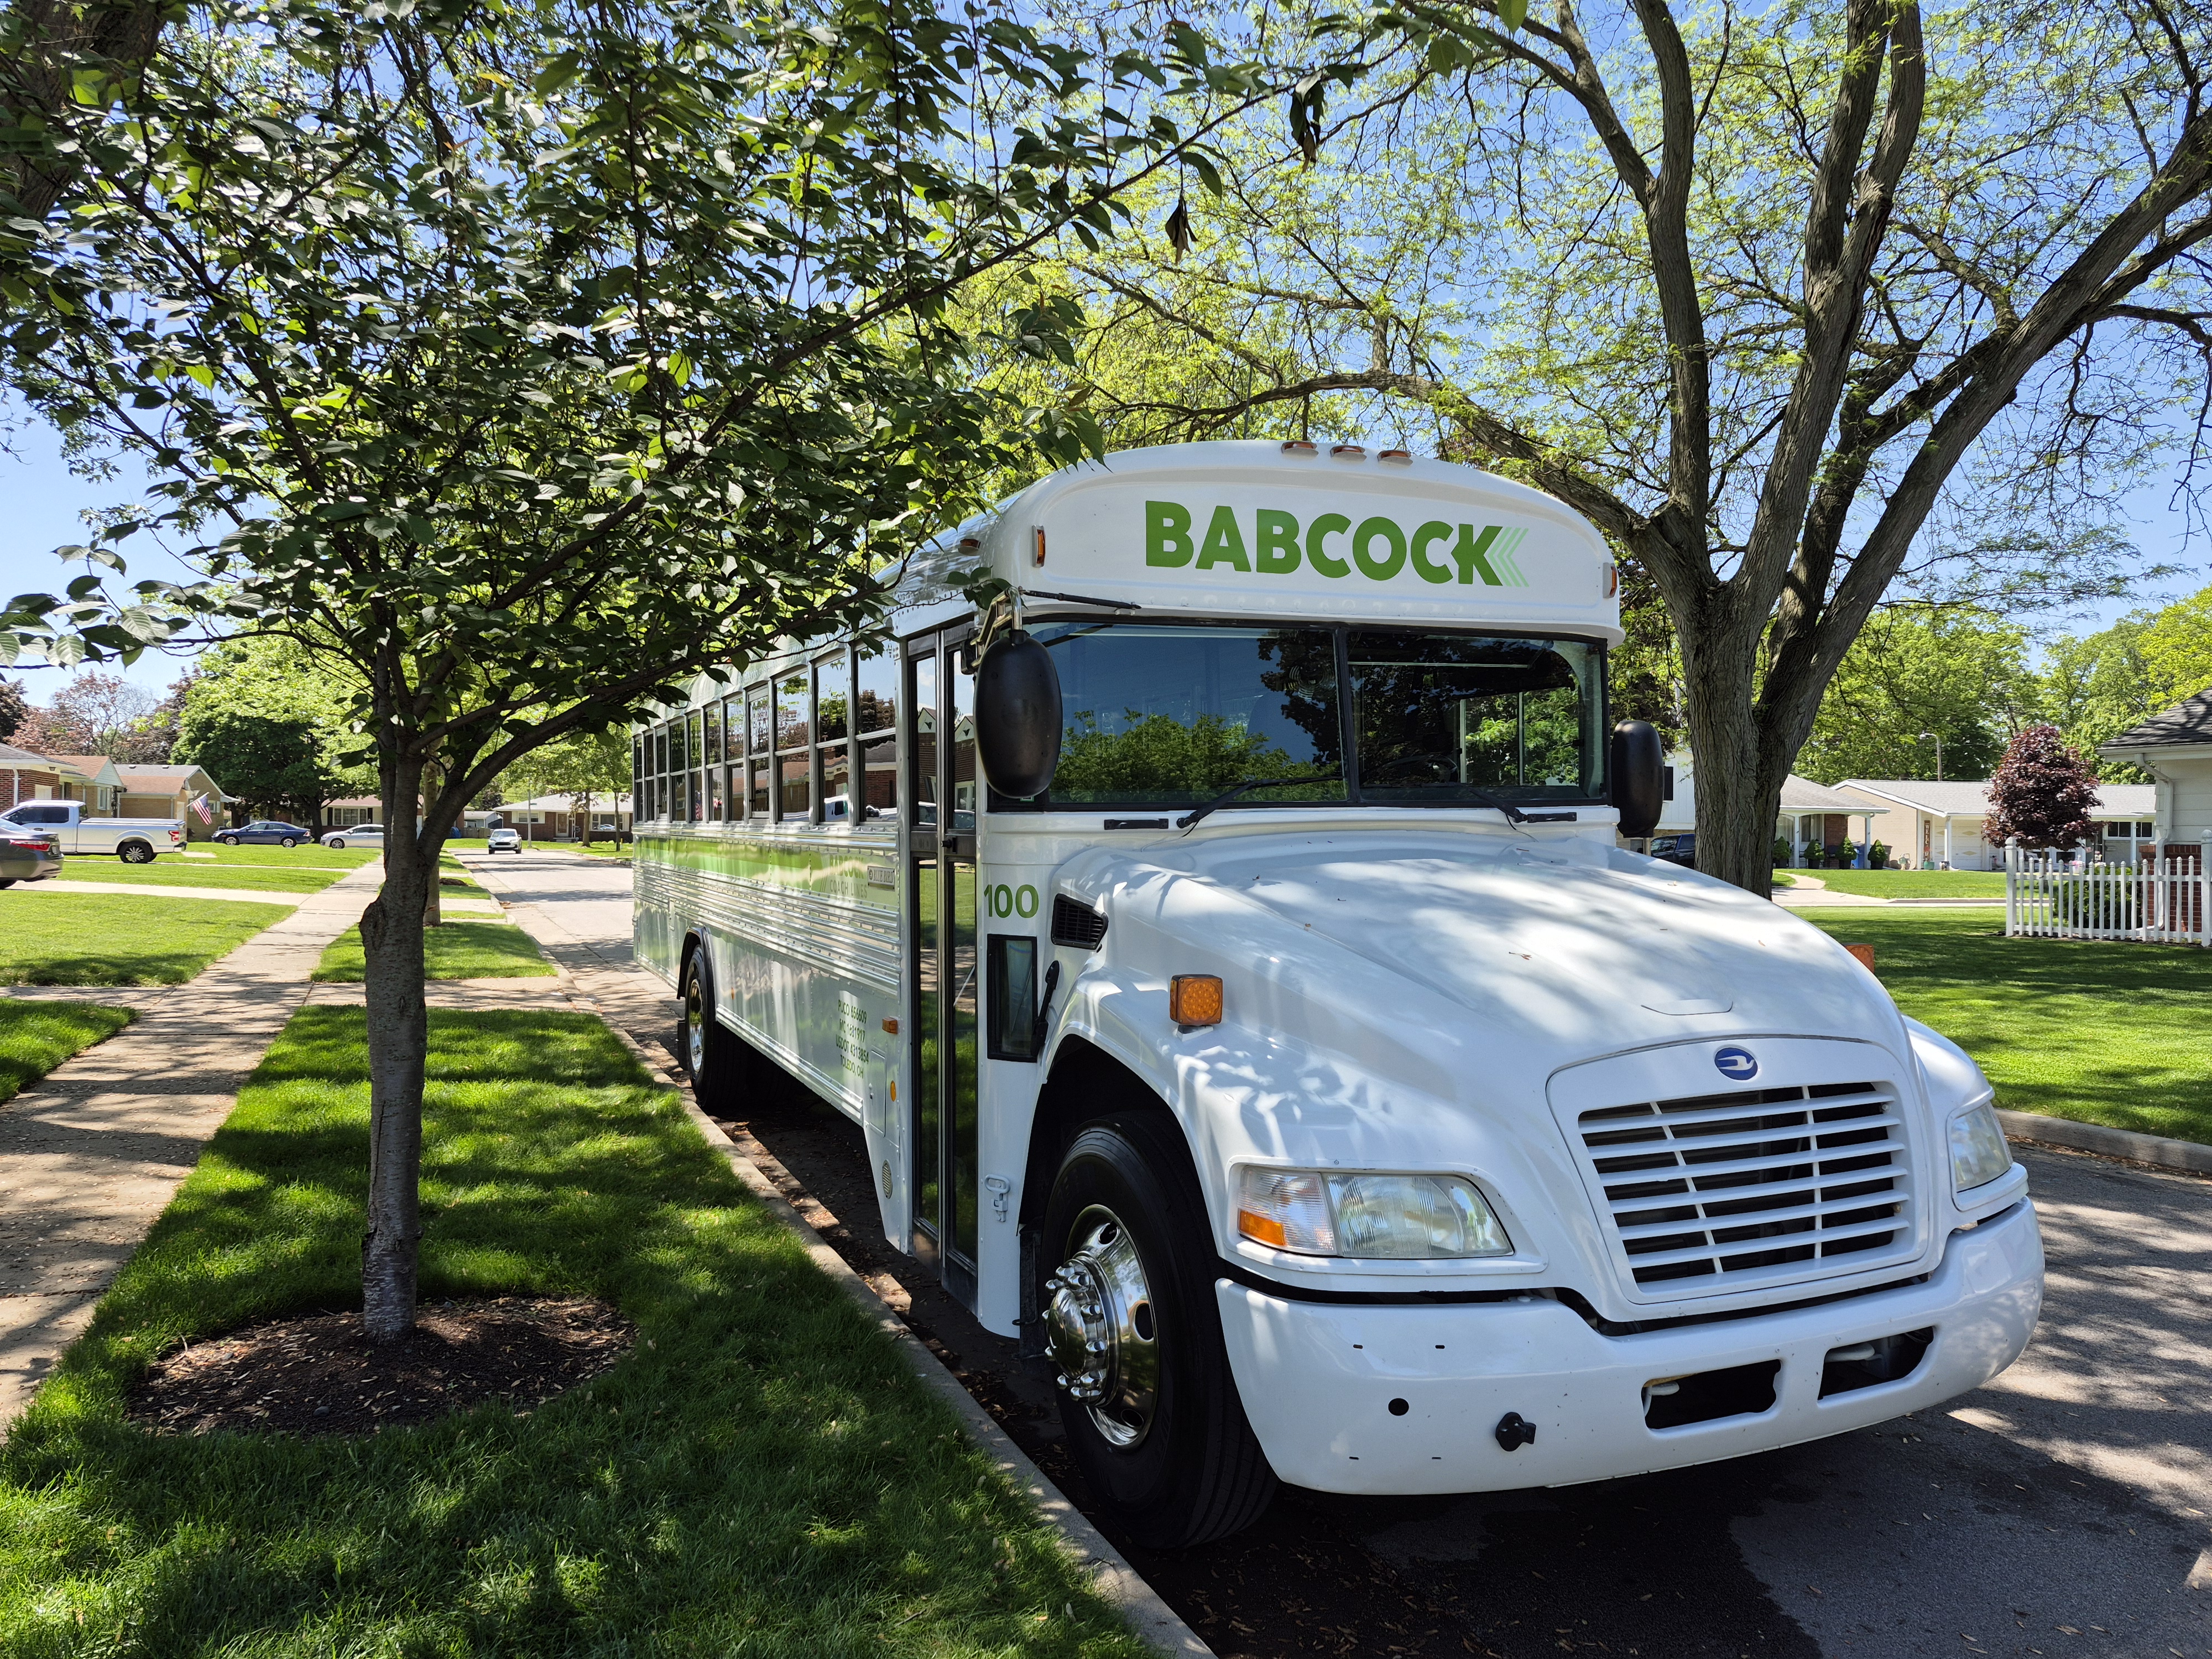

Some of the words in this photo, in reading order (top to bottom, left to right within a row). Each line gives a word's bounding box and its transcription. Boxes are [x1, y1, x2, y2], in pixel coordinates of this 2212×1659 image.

[1145, 500, 1503, 586] BABCOCK
[830, 879, 848, 895] COACH
[851, 883, 868, 899] LINES
[883, 870, 894, 884] BIRD
[983, 884, 1039, 919] 100
[838, 999, 850, 1016] PUCO
[851, 1005, 867, 1024] 656609
[839, 1018, 846, 1034] MC
[847, 1023, 865, 1043] 1681917
[836, 1034, 849, 1053] USDOT
[850, 1043, 869, 1065] 4313854
[840, 1054, 856, 1076] TOLEDO,
[857, 1065, 864, 1079] OH
